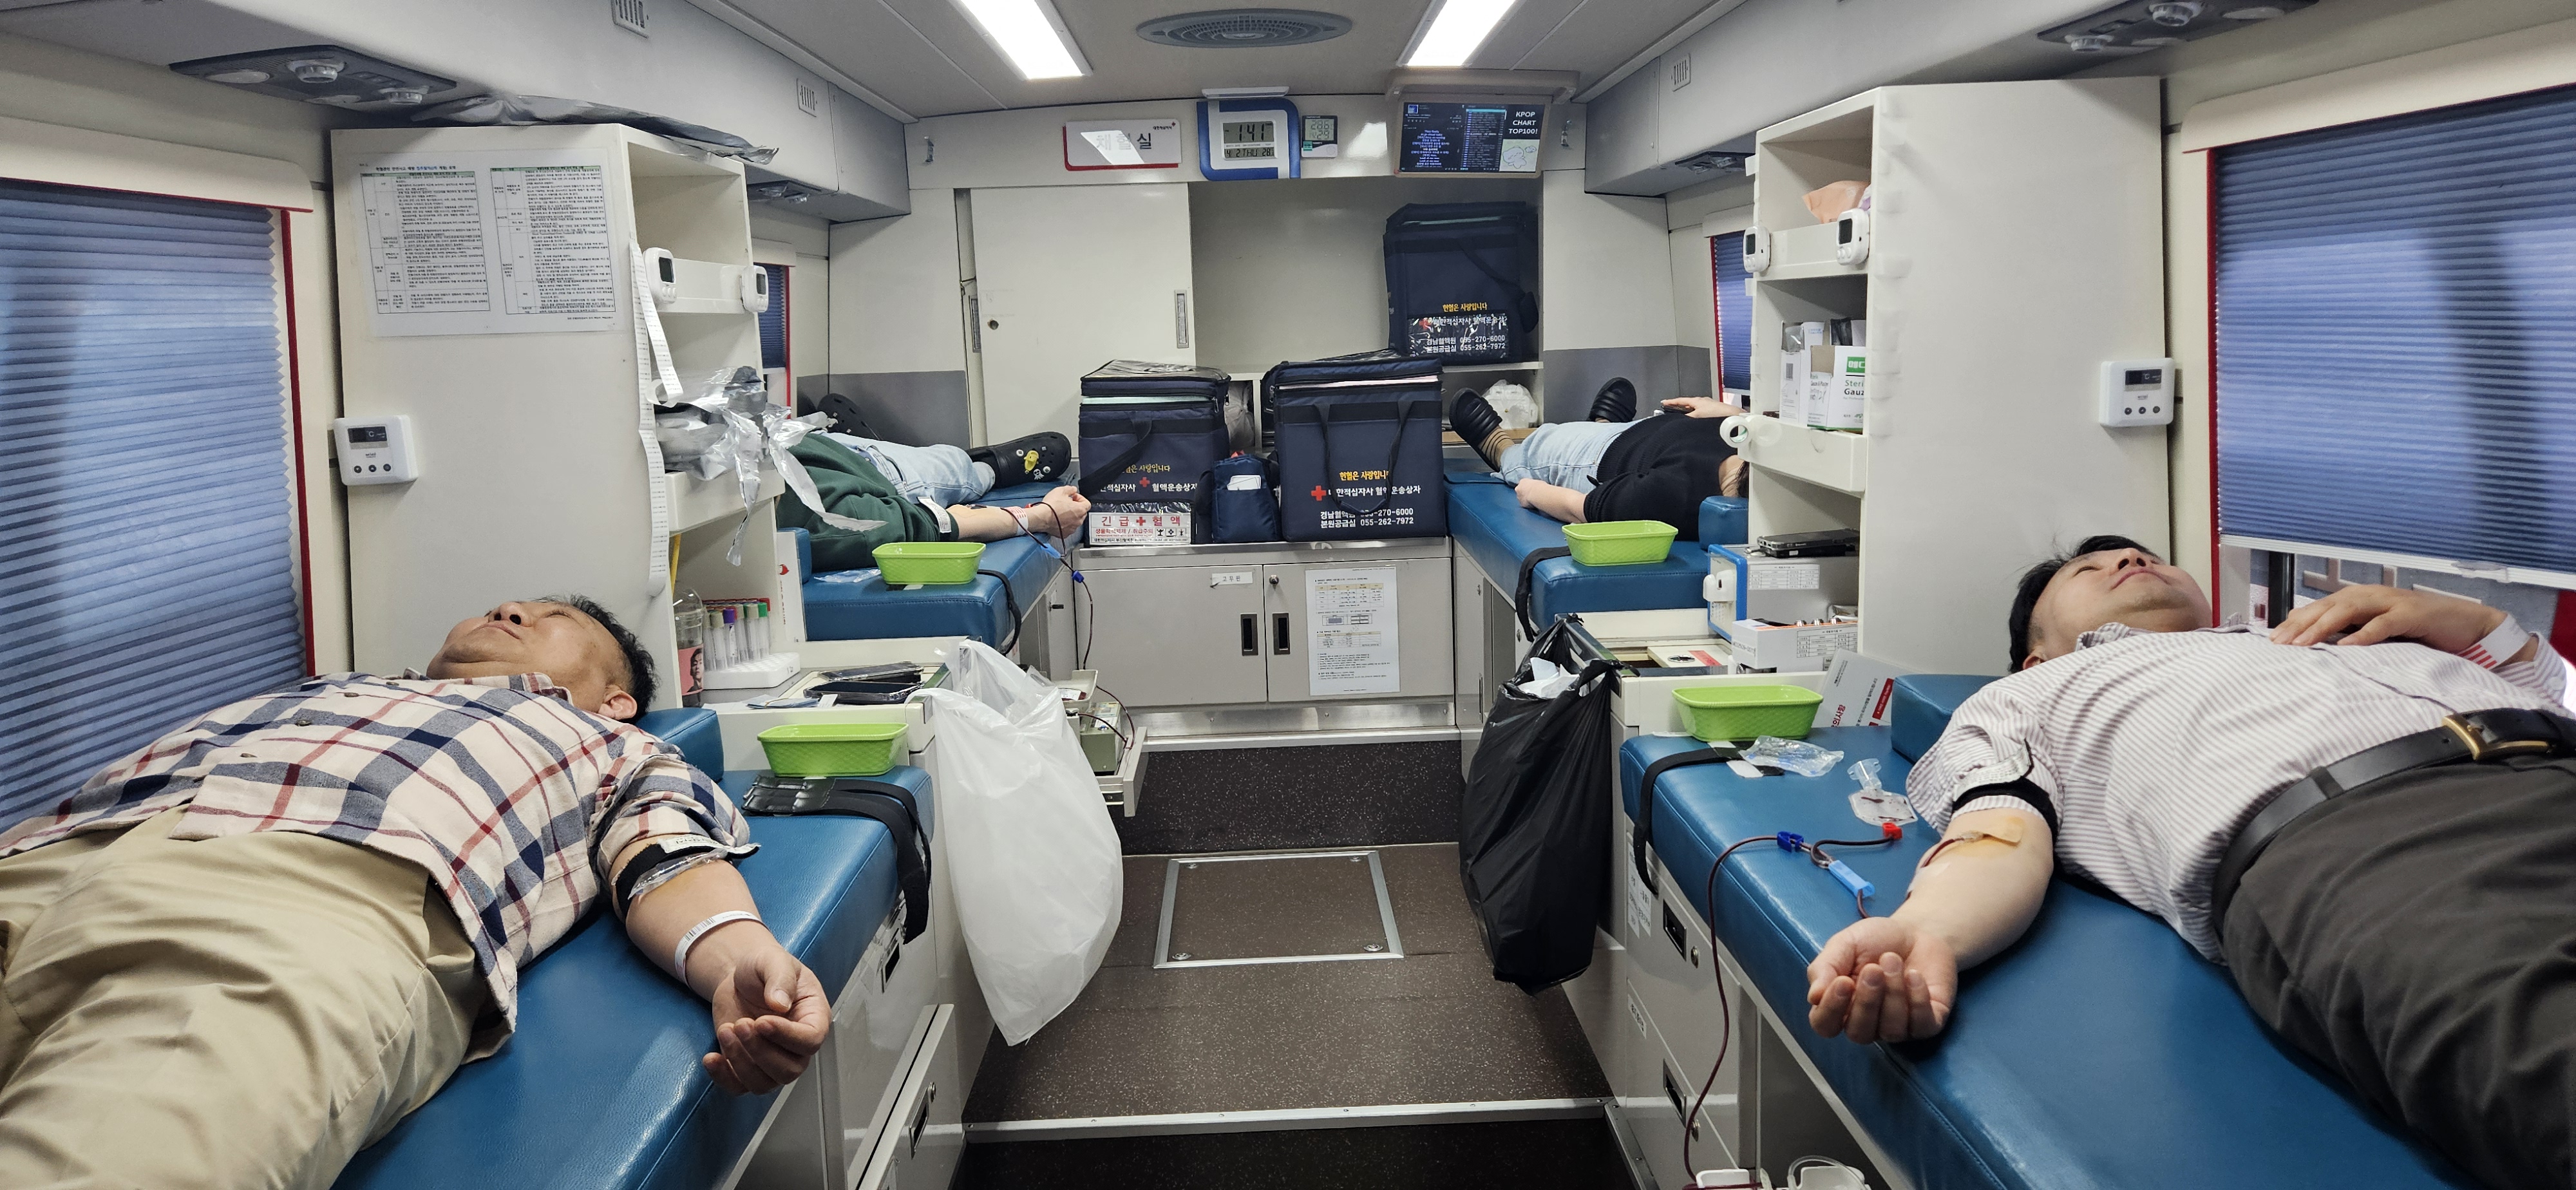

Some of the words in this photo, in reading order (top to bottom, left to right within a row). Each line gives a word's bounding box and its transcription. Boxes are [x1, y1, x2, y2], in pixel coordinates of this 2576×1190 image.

[1096, 133, 1152, 151] 채혈실
[1243, 149, 1258, 157] THU
[1443, 303, 1459, 312] 헌혈은
[1461, 302, 1488, 311] 사랑입니다
[1459, 335, 1506, 343] 055-270-6000
[1460, 343, 1506, 352] 055-262-7972
[1122, 464, 1138, 473] 혈은
[1139, 464, 1171, 473] 사랑입니다
[1339, 471, 1359, 481] 헌혈은
[1101, 484, 1136, 493] 적십자사
[1328, 487, 1374, 497] 한적십자사
[1320, 519, 1356, 529] 본원공급실
[1360, 517, 1414, 527] 055-262-7972
[1831, 704, 1846, 728] 의사항
